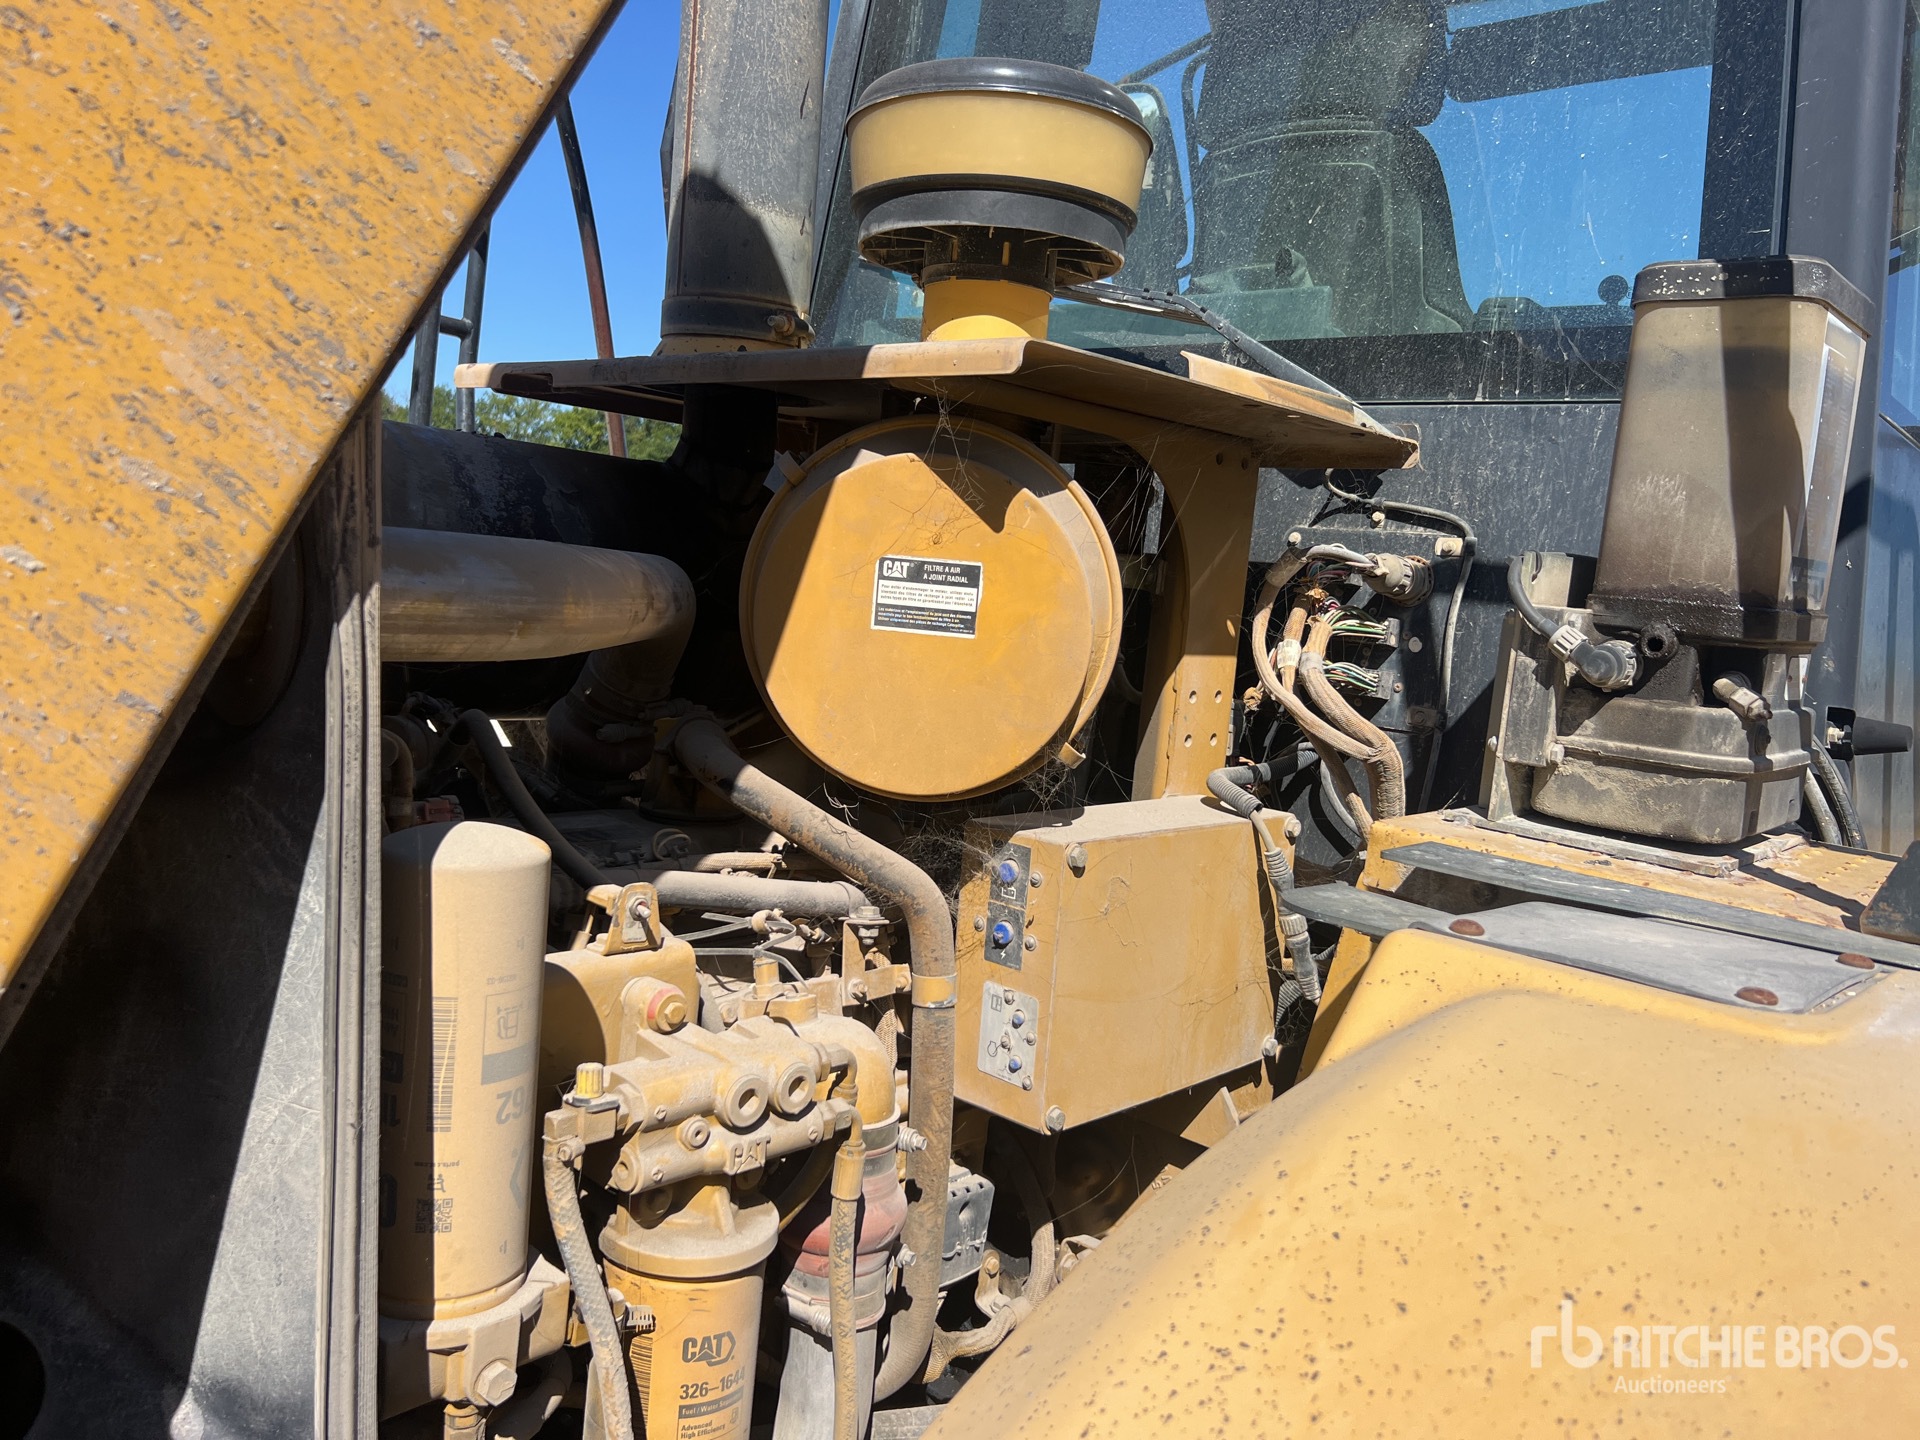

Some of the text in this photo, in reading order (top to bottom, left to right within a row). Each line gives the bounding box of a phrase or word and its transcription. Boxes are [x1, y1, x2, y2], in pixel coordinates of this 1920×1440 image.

[924, 564, 944, 572] FILTRE
[929, 574, 946, 582] JOINT
[947, 575, 968, 583] RADIAL
[682, 1332, 728, 1365] CAT
[682, 1408, 696, 1416] Fuel
[700, 1403, 719, 1413] Water
[681, 1420, 713, 1432] Advanced
[681, 1424, 726, 1440] High Efficiency
